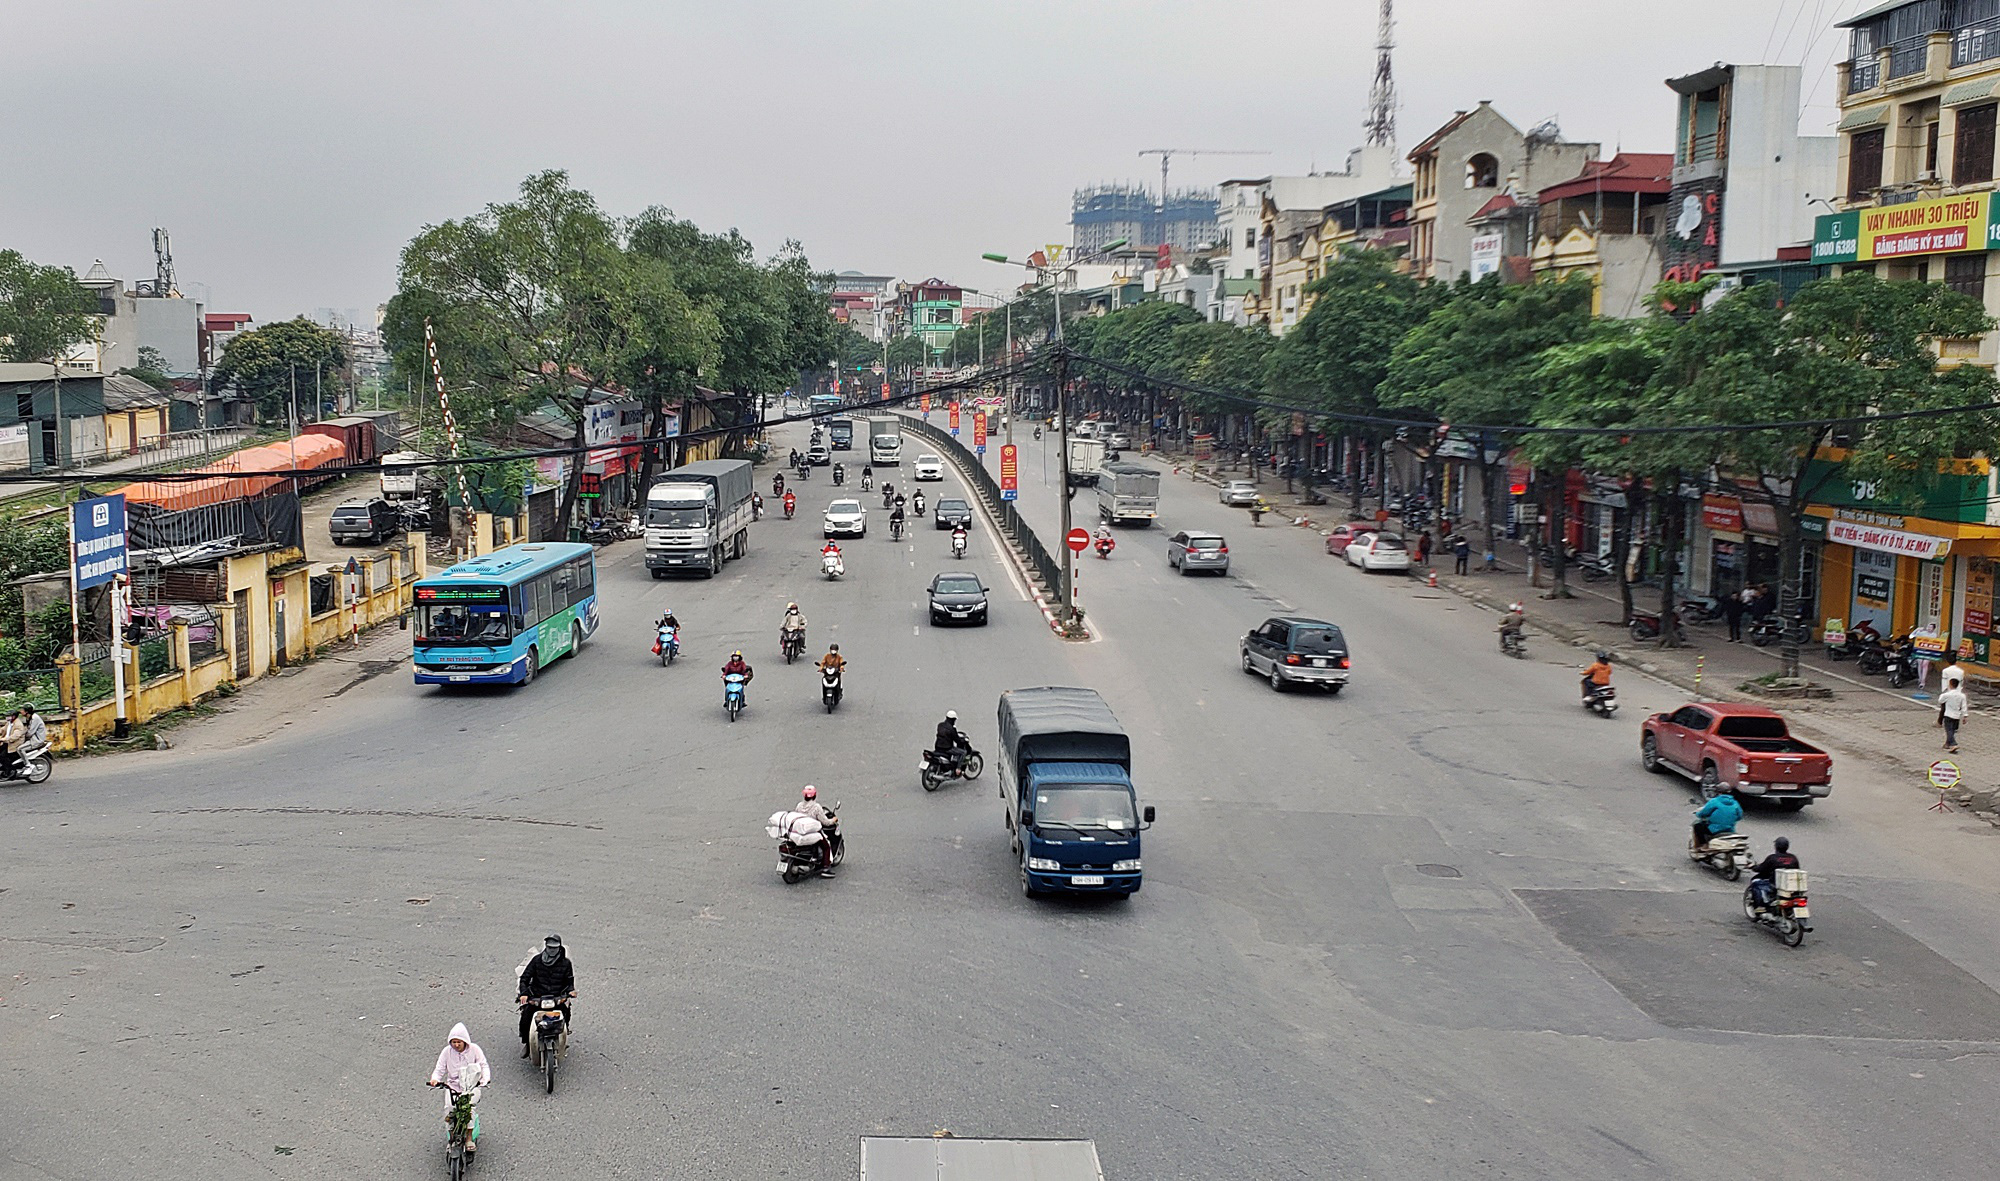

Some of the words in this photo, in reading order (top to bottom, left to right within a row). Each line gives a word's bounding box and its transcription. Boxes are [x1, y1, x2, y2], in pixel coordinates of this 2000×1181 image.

[1867, 213, 1885, 232] VAY
[1888, 208, 1925, 230] NHANH
[1928, 205, 1942, 225] 30
[1945, 197, 1979, 224] TRIỆU
[1814, 241, 1834, 257] 1800
[1835, 238, 1857, 255] 6388
[1875, 235, 1896, 255] BẰNG
[1897, 233, 1919, 252] ĐĂNG
[1920, 232, 1931, 251] KÝ
[1932, 234, 1943, 250] XE
[1945, 229, 1965, 248] MÁY
[1904, 539, 1916, 551] XE
[1915, 539, 1932, 553] MÁY
